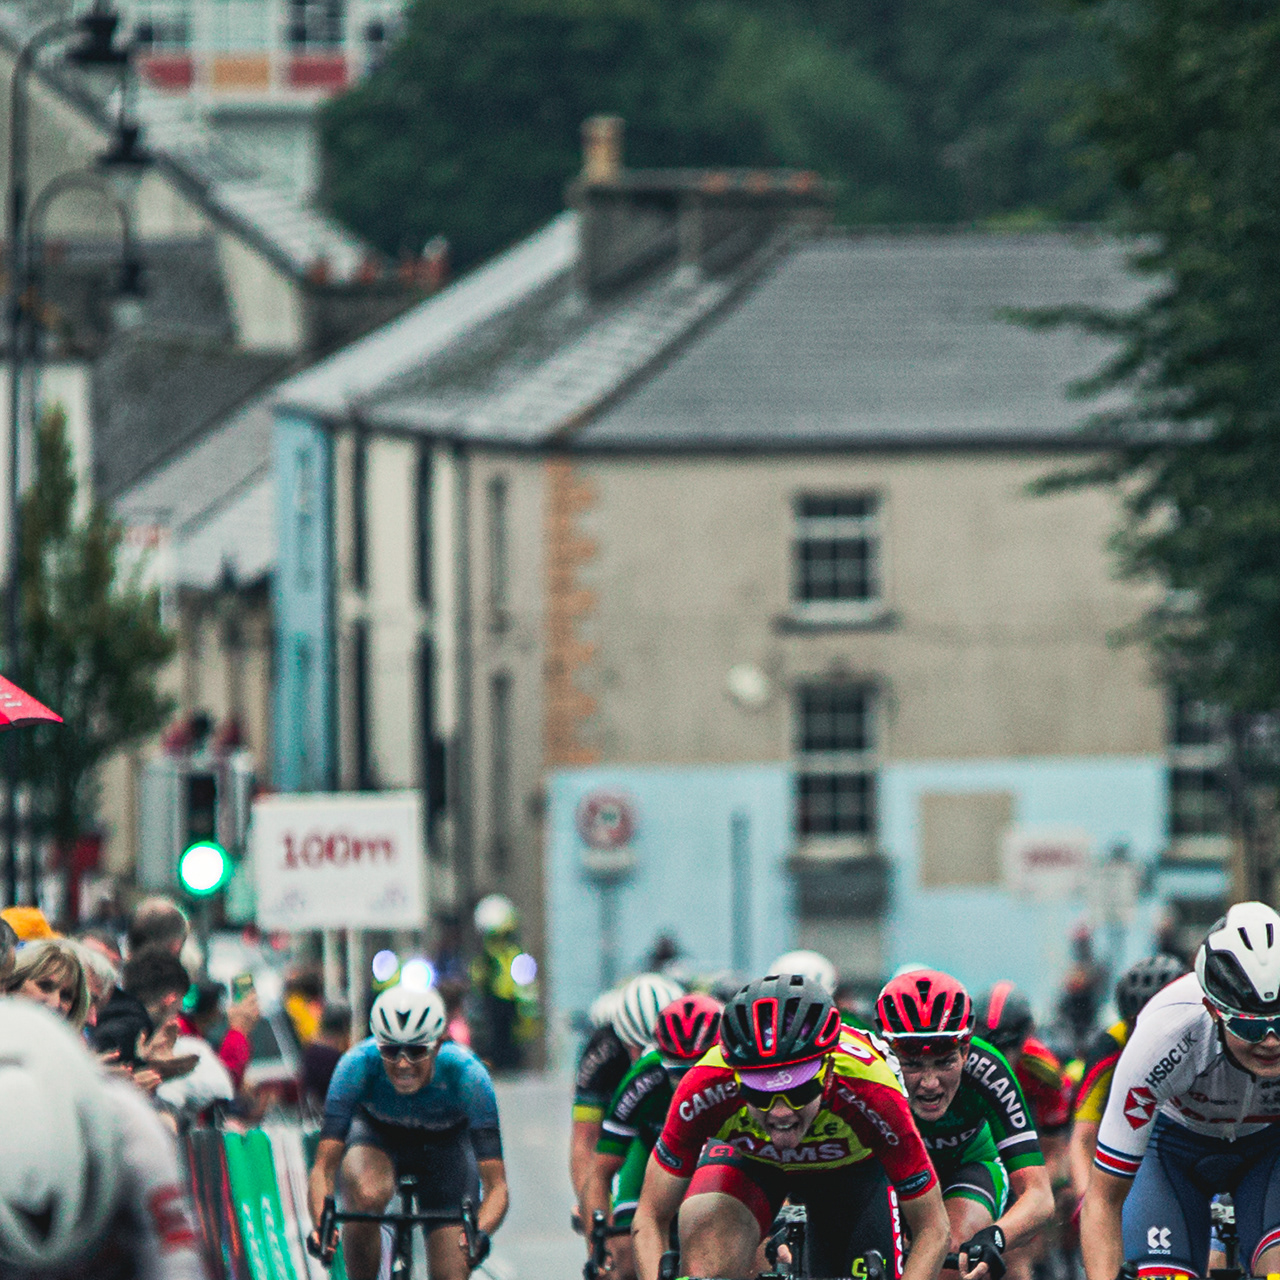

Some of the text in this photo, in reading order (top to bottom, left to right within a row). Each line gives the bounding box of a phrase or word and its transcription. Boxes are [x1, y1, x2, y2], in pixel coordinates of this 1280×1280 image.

[280, 830, 397, 871] 100m
[1145, 1031, 1198, 1088] HSBC UK
[678, 1080, 738, 1122] CAMS
[836, 1087, 899, 1146] BASSO
